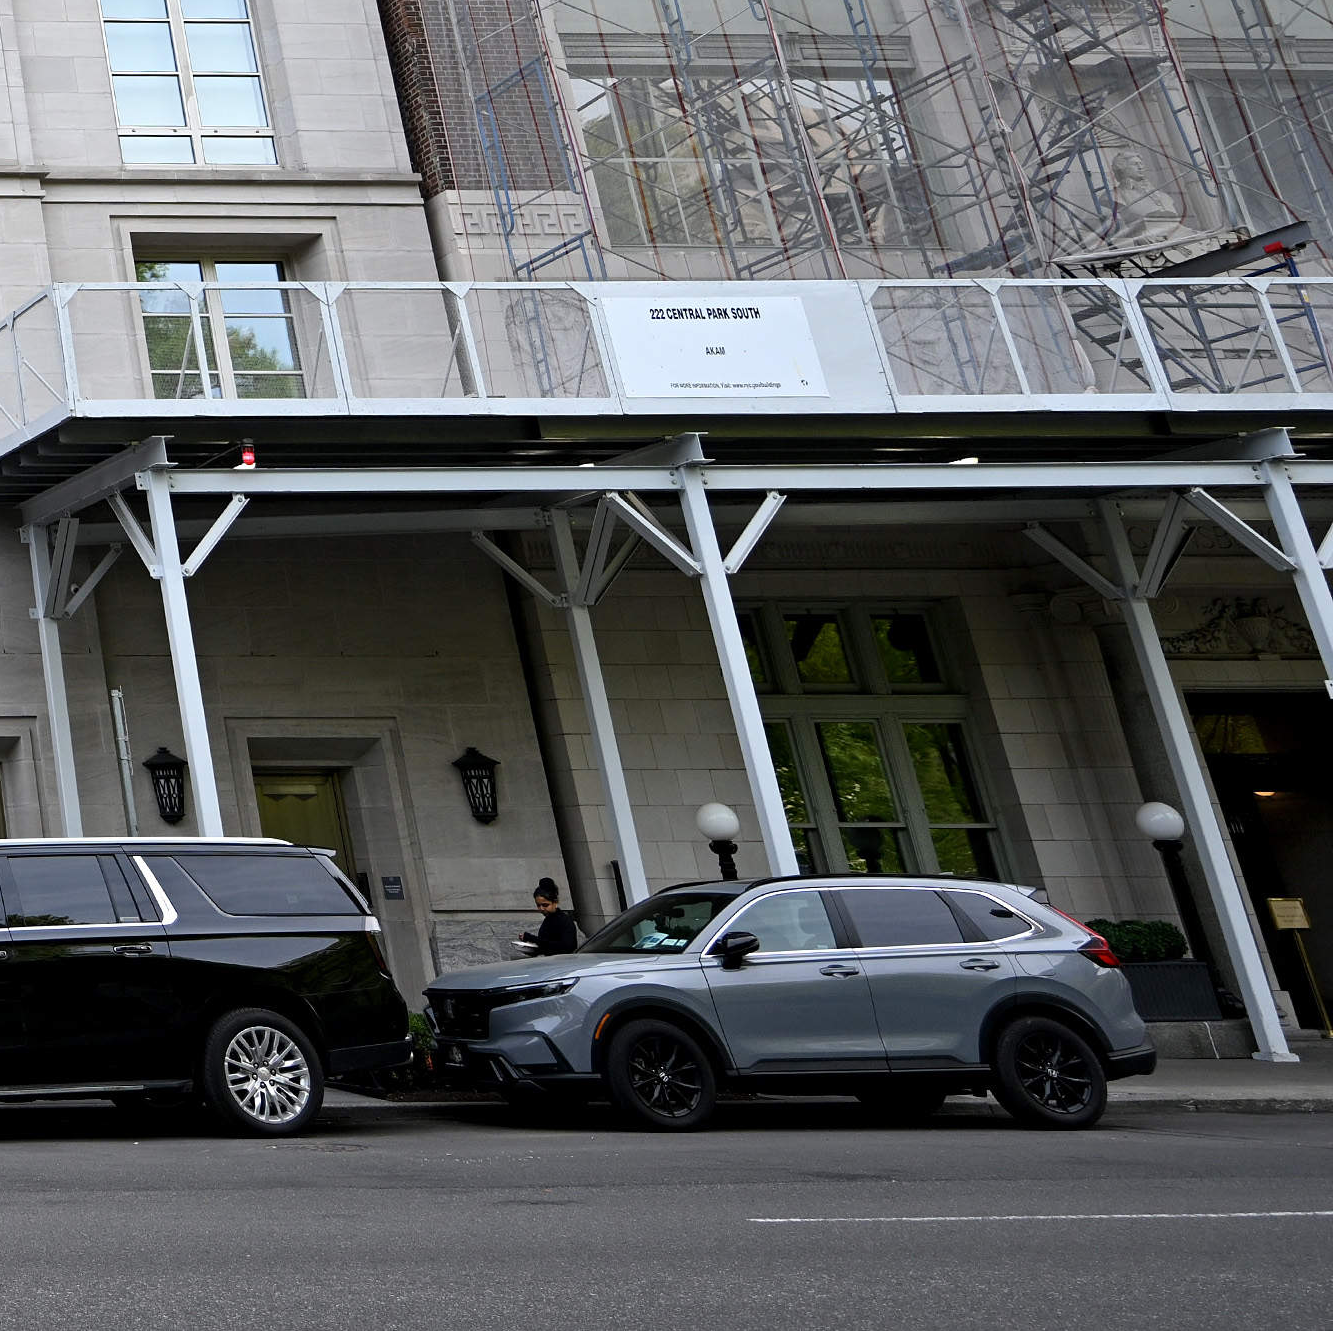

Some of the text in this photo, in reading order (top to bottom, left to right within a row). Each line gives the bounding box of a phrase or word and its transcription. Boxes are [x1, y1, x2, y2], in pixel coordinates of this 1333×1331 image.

[649, 307, 761, 320] 222 CENTRAL PARK SOUTH
[705, 346, 726, 356] AKAM
